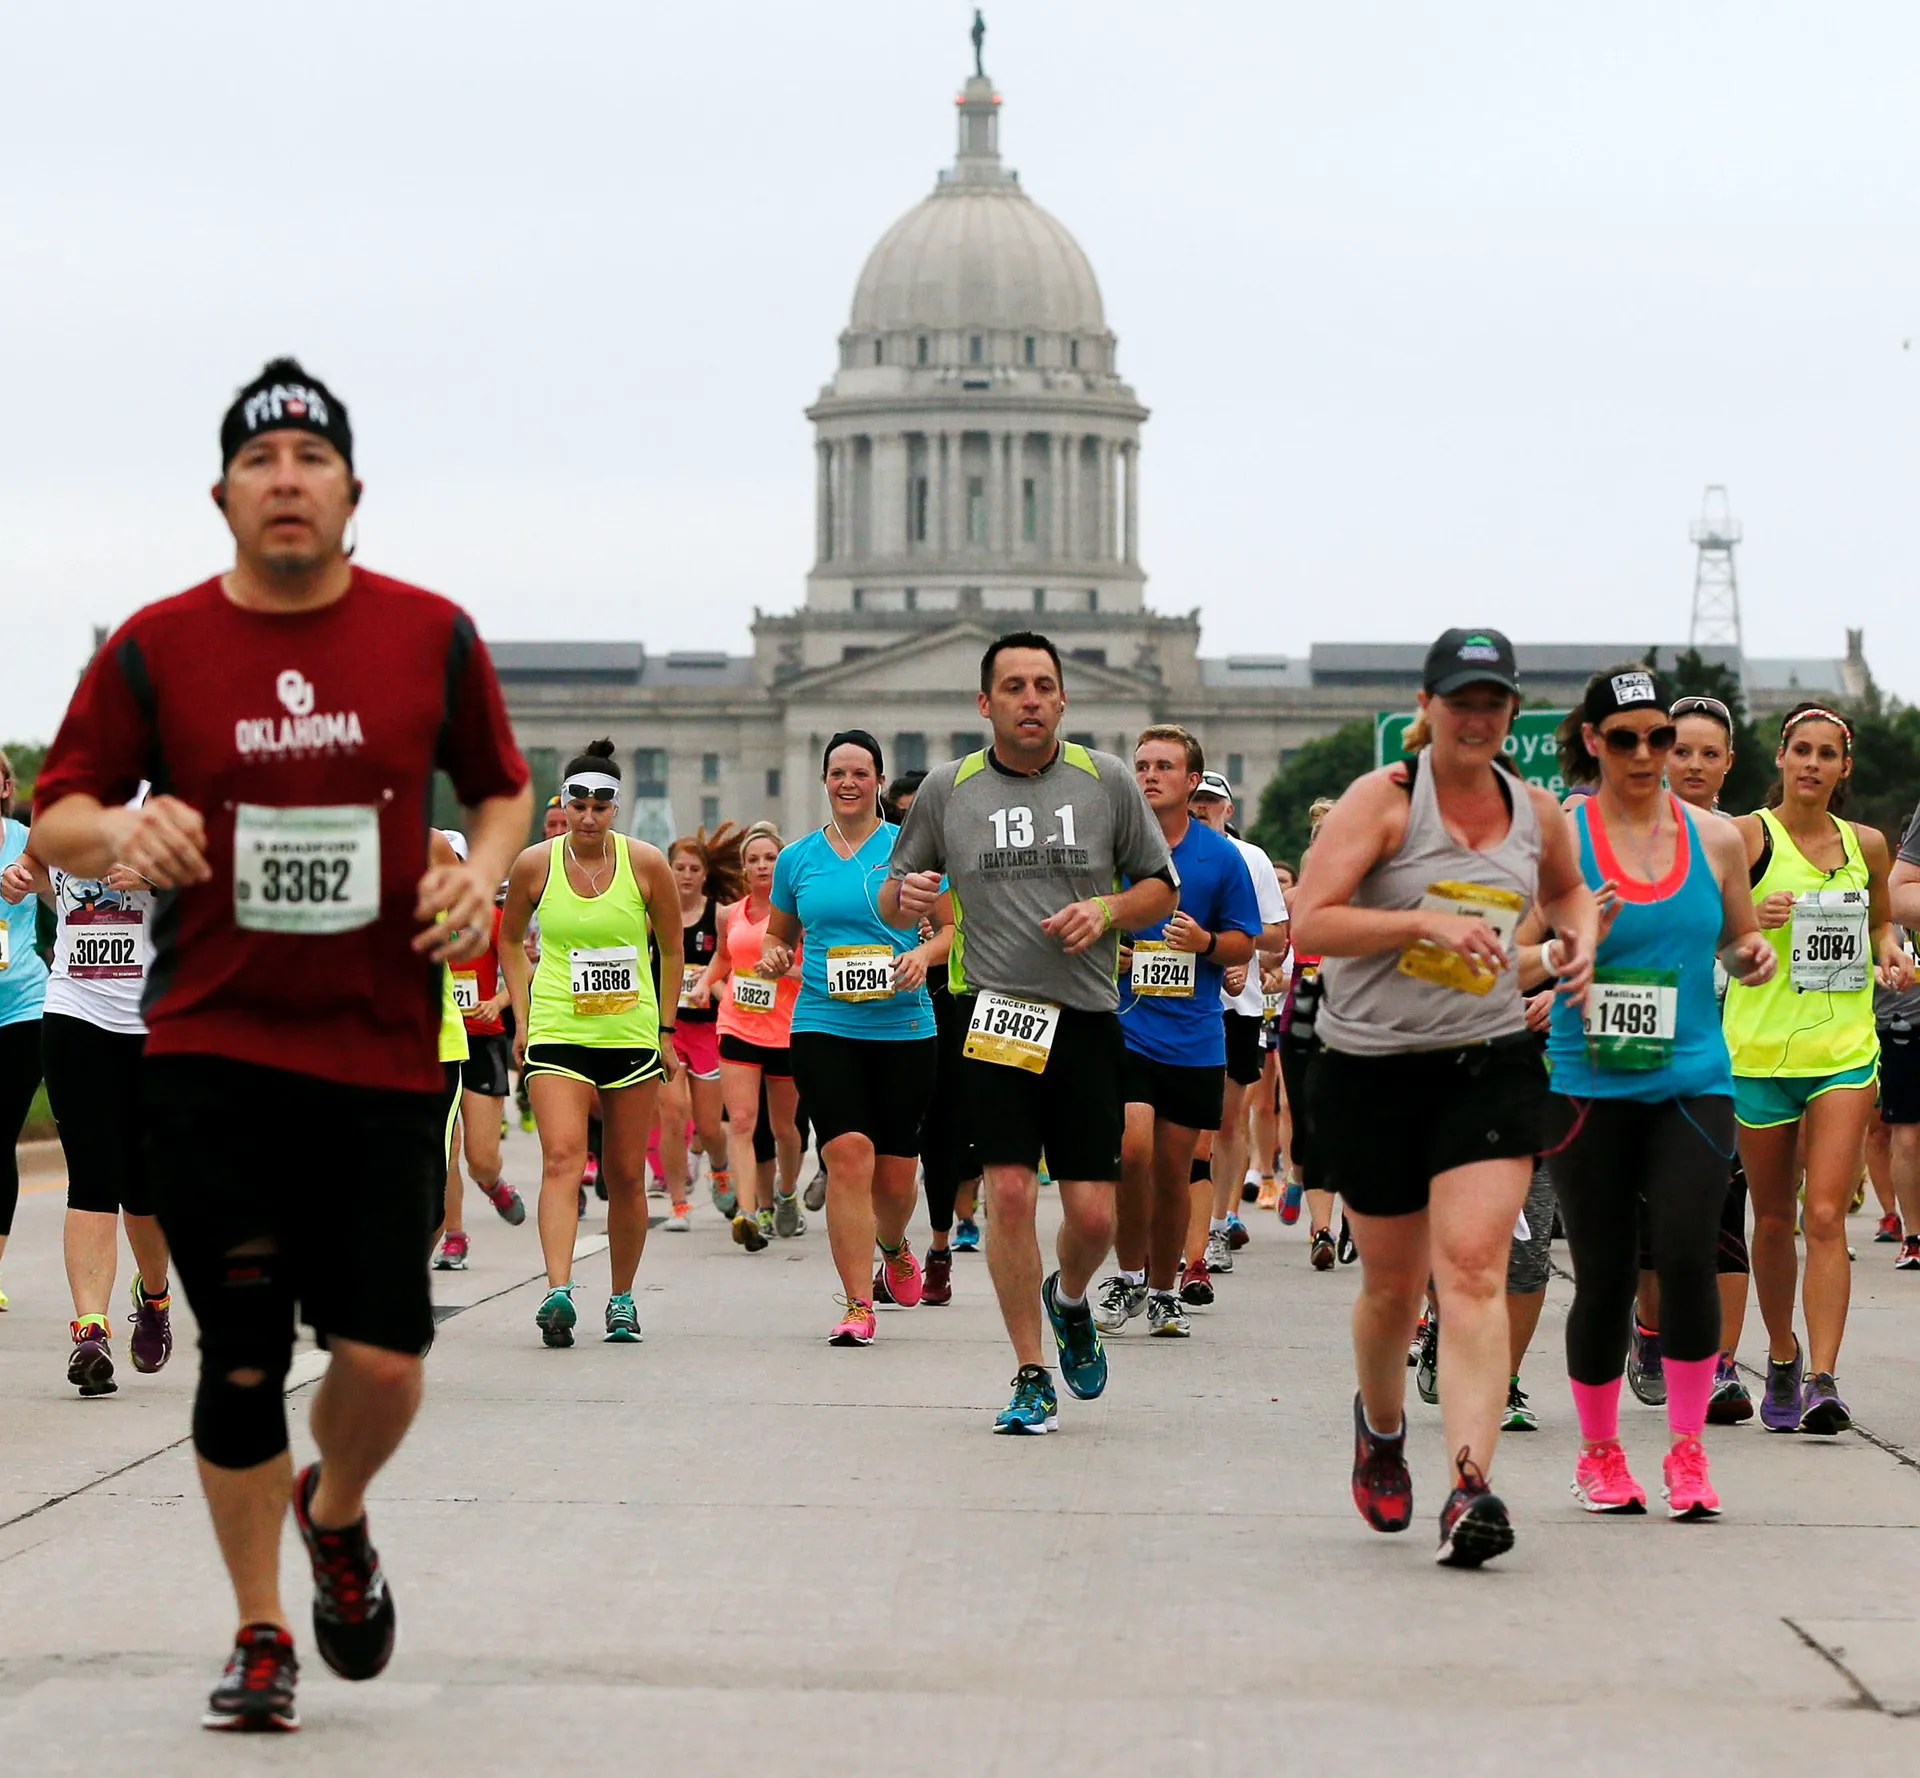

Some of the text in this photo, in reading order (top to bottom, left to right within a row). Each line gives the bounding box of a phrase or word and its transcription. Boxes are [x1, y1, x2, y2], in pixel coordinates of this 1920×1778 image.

[276, 669, 314, 716] OU
[235, 711, 363, 754] OKLAHOMA
[1501, 733, 1567, 763] oya
[988, 806, 1035, 849] 13
[984, 851, 1005, 869] BEAT
[1007, 849, 1039, 867] CANCER
[262, 859, 352, 903] 3362
[1816, 925, 1849, 933] Hannah
[69, 938, 135, 965] A 30202
[1793, 934, 1855, 962] C 3084
[573, 968, 631, 992] D 13688
[829, 968, 888, 992] D 16294
[1133, 963, 1189, 985] C 13244
[453, 990, 471, 1007] 21
[737, 986, 771, 1006] 13823
[990, 997, 1047, 1015] CANCER SUX
[971, 1007, 1050, 1043] B 13487
[1598, 1002, 1657, 1035] 1493
